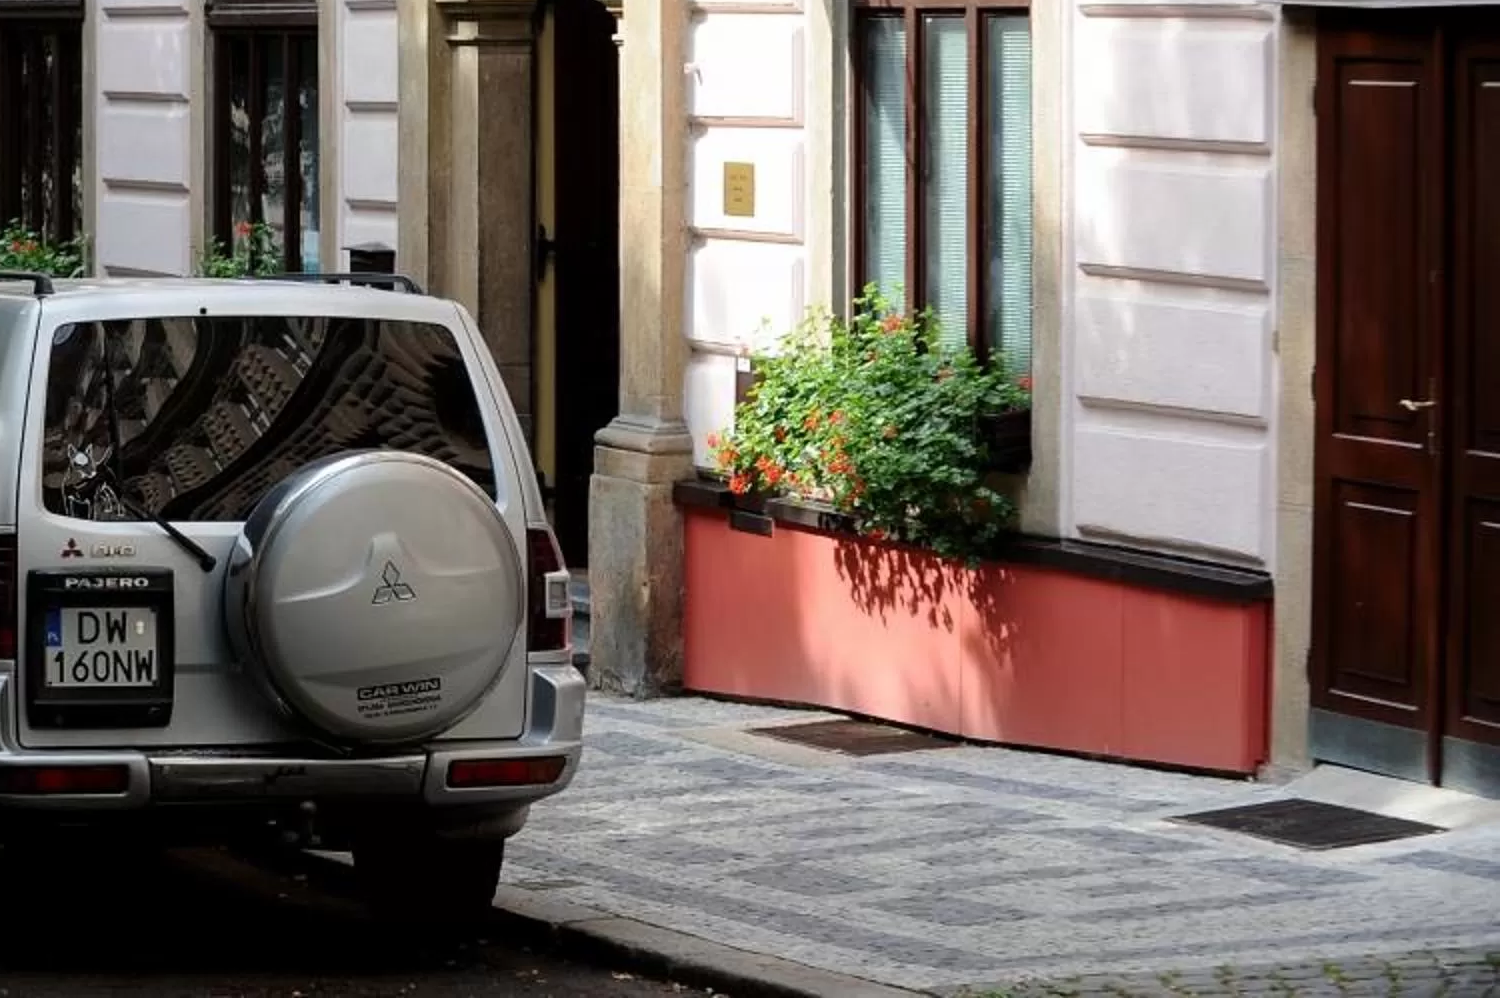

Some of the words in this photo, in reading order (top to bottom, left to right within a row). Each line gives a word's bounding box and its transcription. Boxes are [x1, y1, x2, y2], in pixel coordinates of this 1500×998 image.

[65, 577, 149, 589] PAJERO
[78, 611, 127, 644] DW
[54, 650, 153, 683] 160NW
